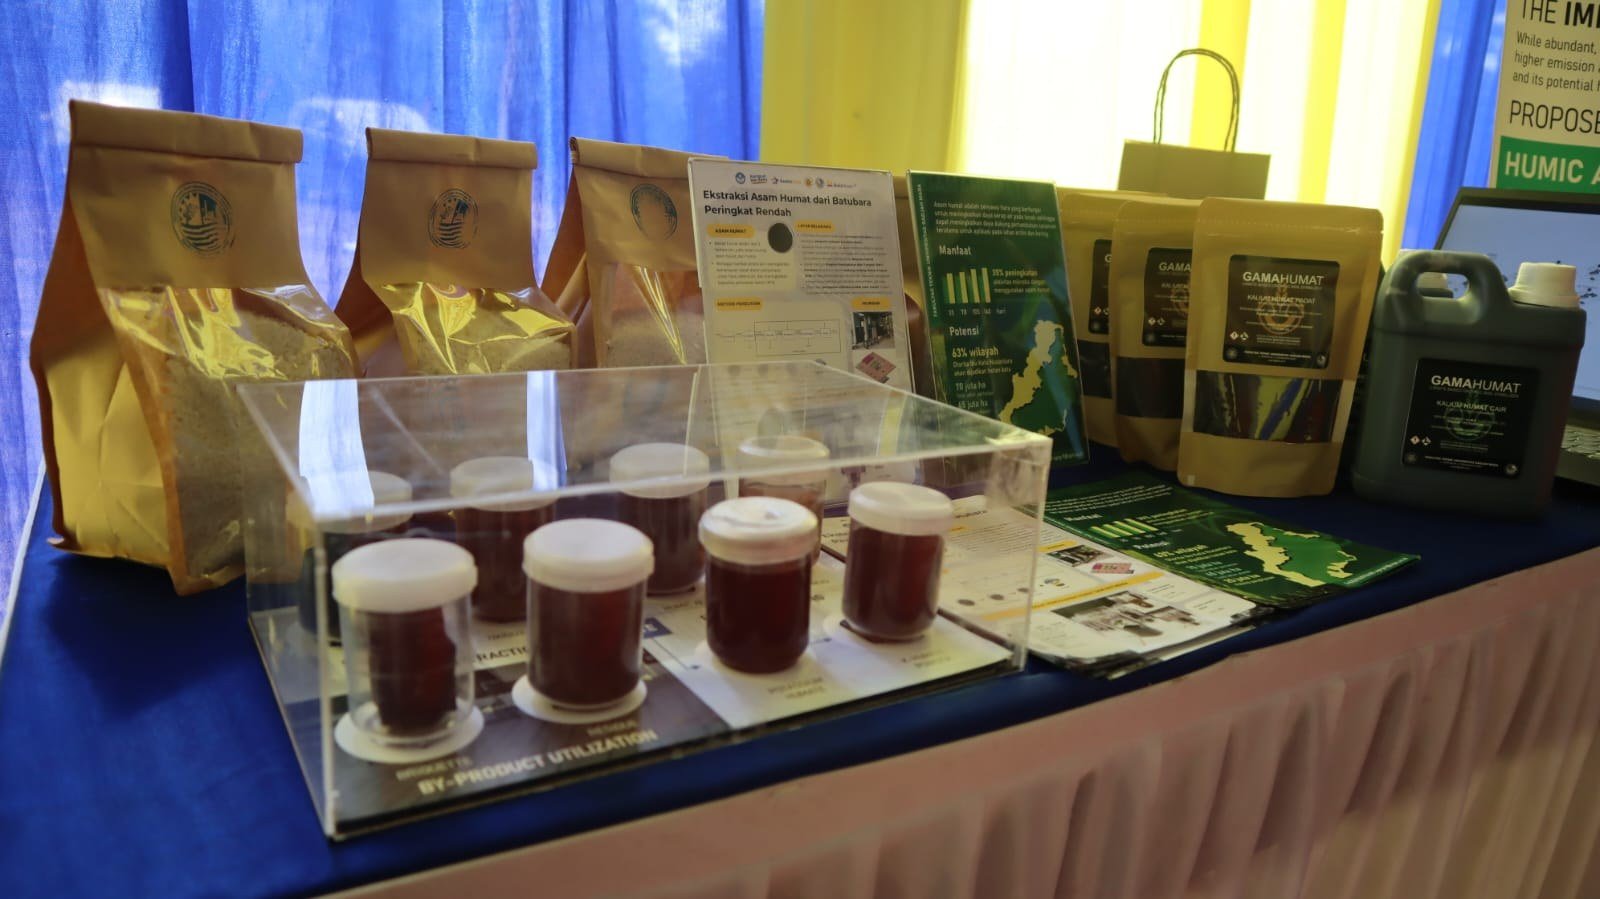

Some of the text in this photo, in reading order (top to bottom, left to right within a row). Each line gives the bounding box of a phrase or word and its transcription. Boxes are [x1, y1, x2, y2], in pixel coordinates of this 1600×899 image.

[1522, 0, 1600, 29] THE IM
[1516, 30, 1597, 55] While abundant,
[1514, 50, 1595, 73] higher emission
[1512, 71, 1594, 92] and its potential
[1505, 151, 1584, 184] HUMIC
[704, 190, 872, 207] Ekstraksi Asam Humat dari Batubara
[704, 206, 792, 217] Peringkat Rendah
[939, 245, 972, 256] Manfaat
[1242, 272, 1324, 285] GAMAHUMAT
[950, 326, 979, 336] Potensi
[952, 346, 998, 358] 63% wilayah
[1431, 375, 1522, 393] GAMAHUMAT
[1463, 402, 1489, 411] HUMAT
[417, 730, 659, 795] BY-PRODUCT UTILIZATION
